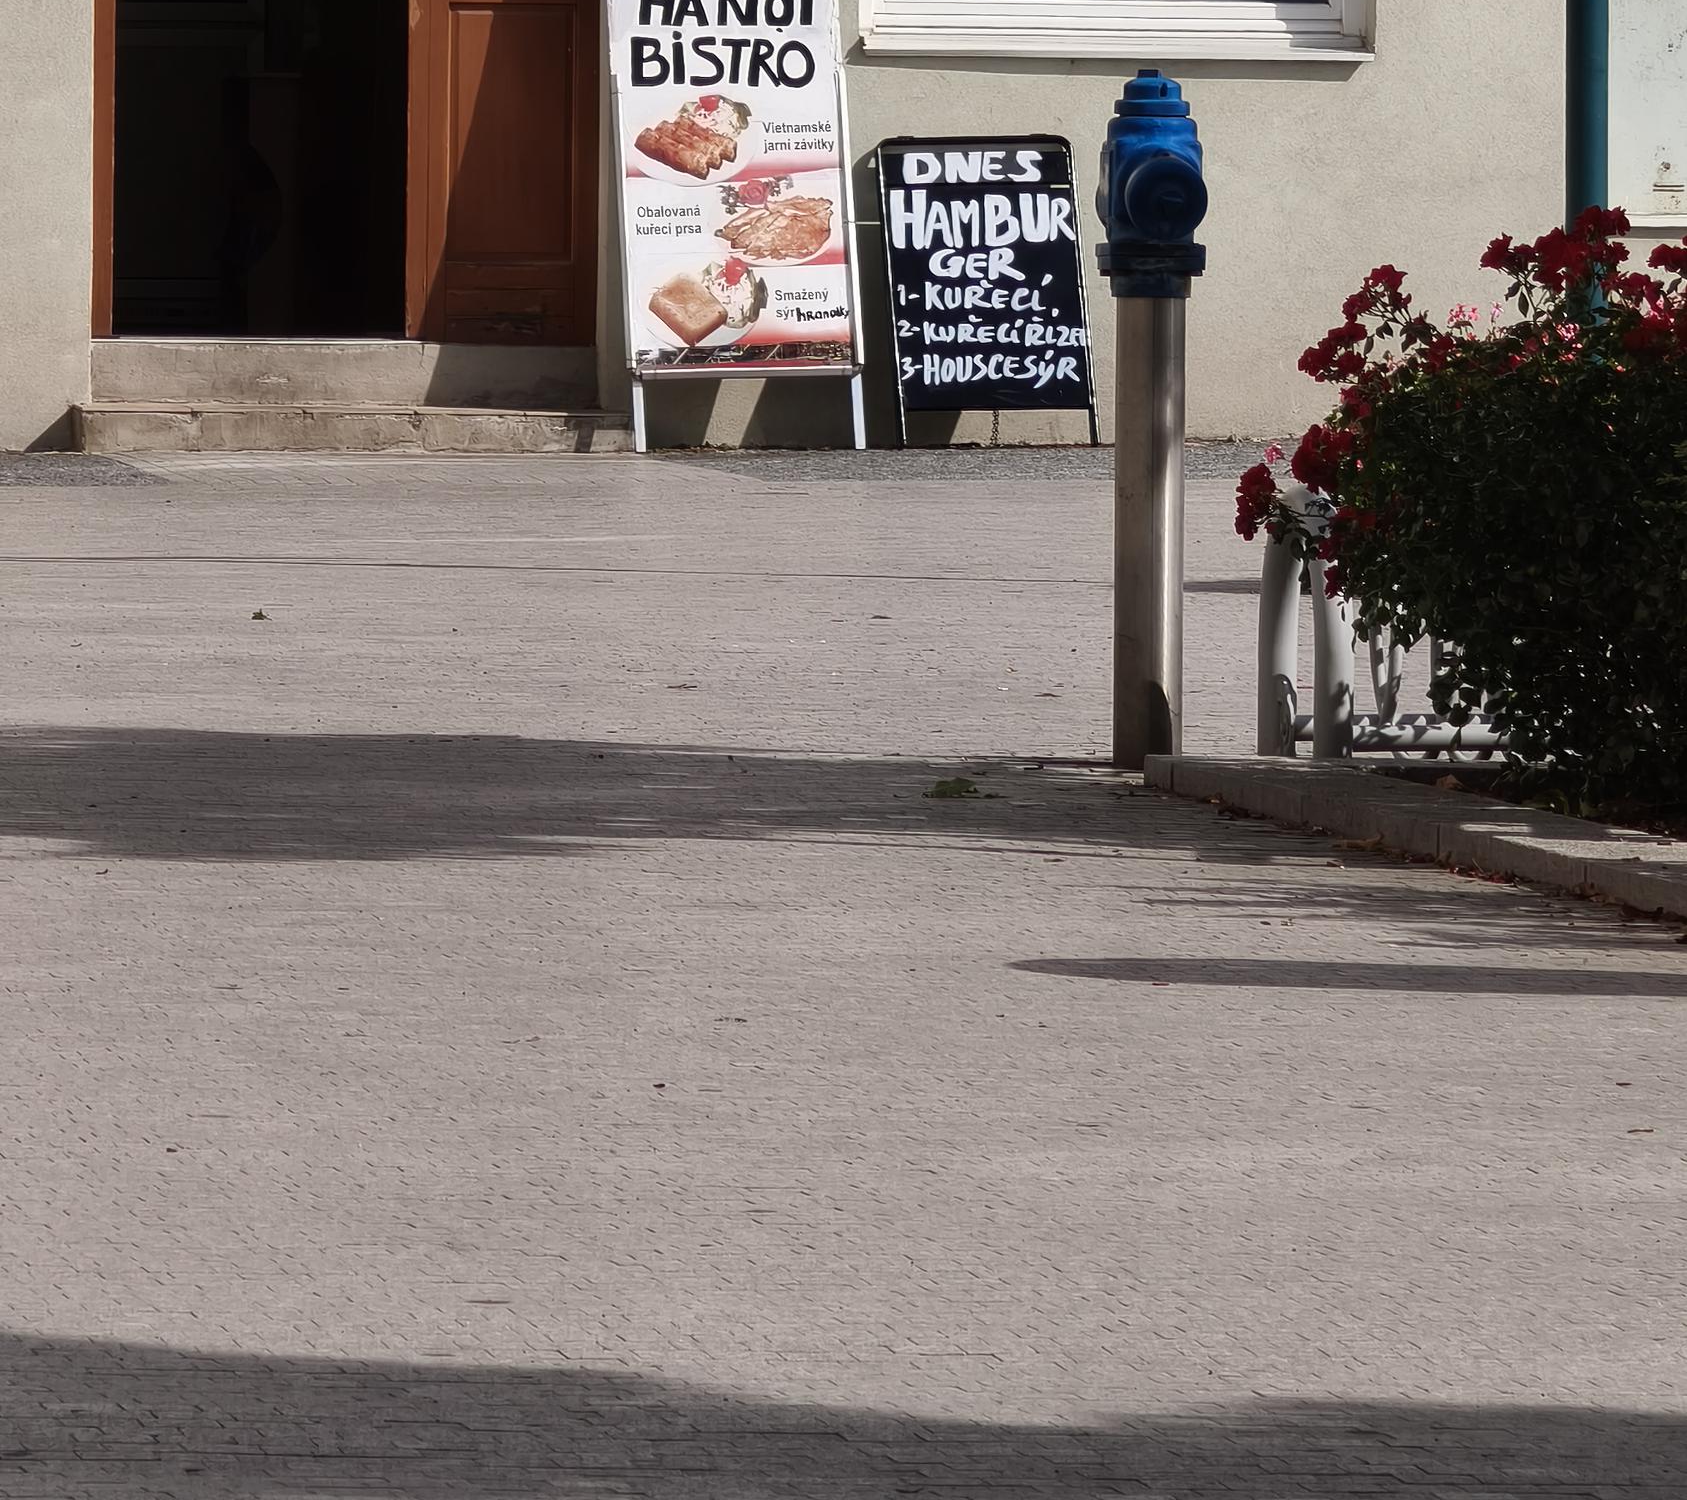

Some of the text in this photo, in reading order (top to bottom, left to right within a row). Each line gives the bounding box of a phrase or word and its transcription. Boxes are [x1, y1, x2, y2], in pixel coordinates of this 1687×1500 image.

[762, 120, 832, 134] Vietnamské
[902, 150, 1043, 184] DNES
[637, 204, 701, 218] Obalovaná
[889, 189, 1076, 250] HAMBUR
[675, 225, 702, 237] prsa
[928, 247, 1026, 281] GER
[774, 288, 829, 302] Smažený
[775, 306, 794, 320] sýr
